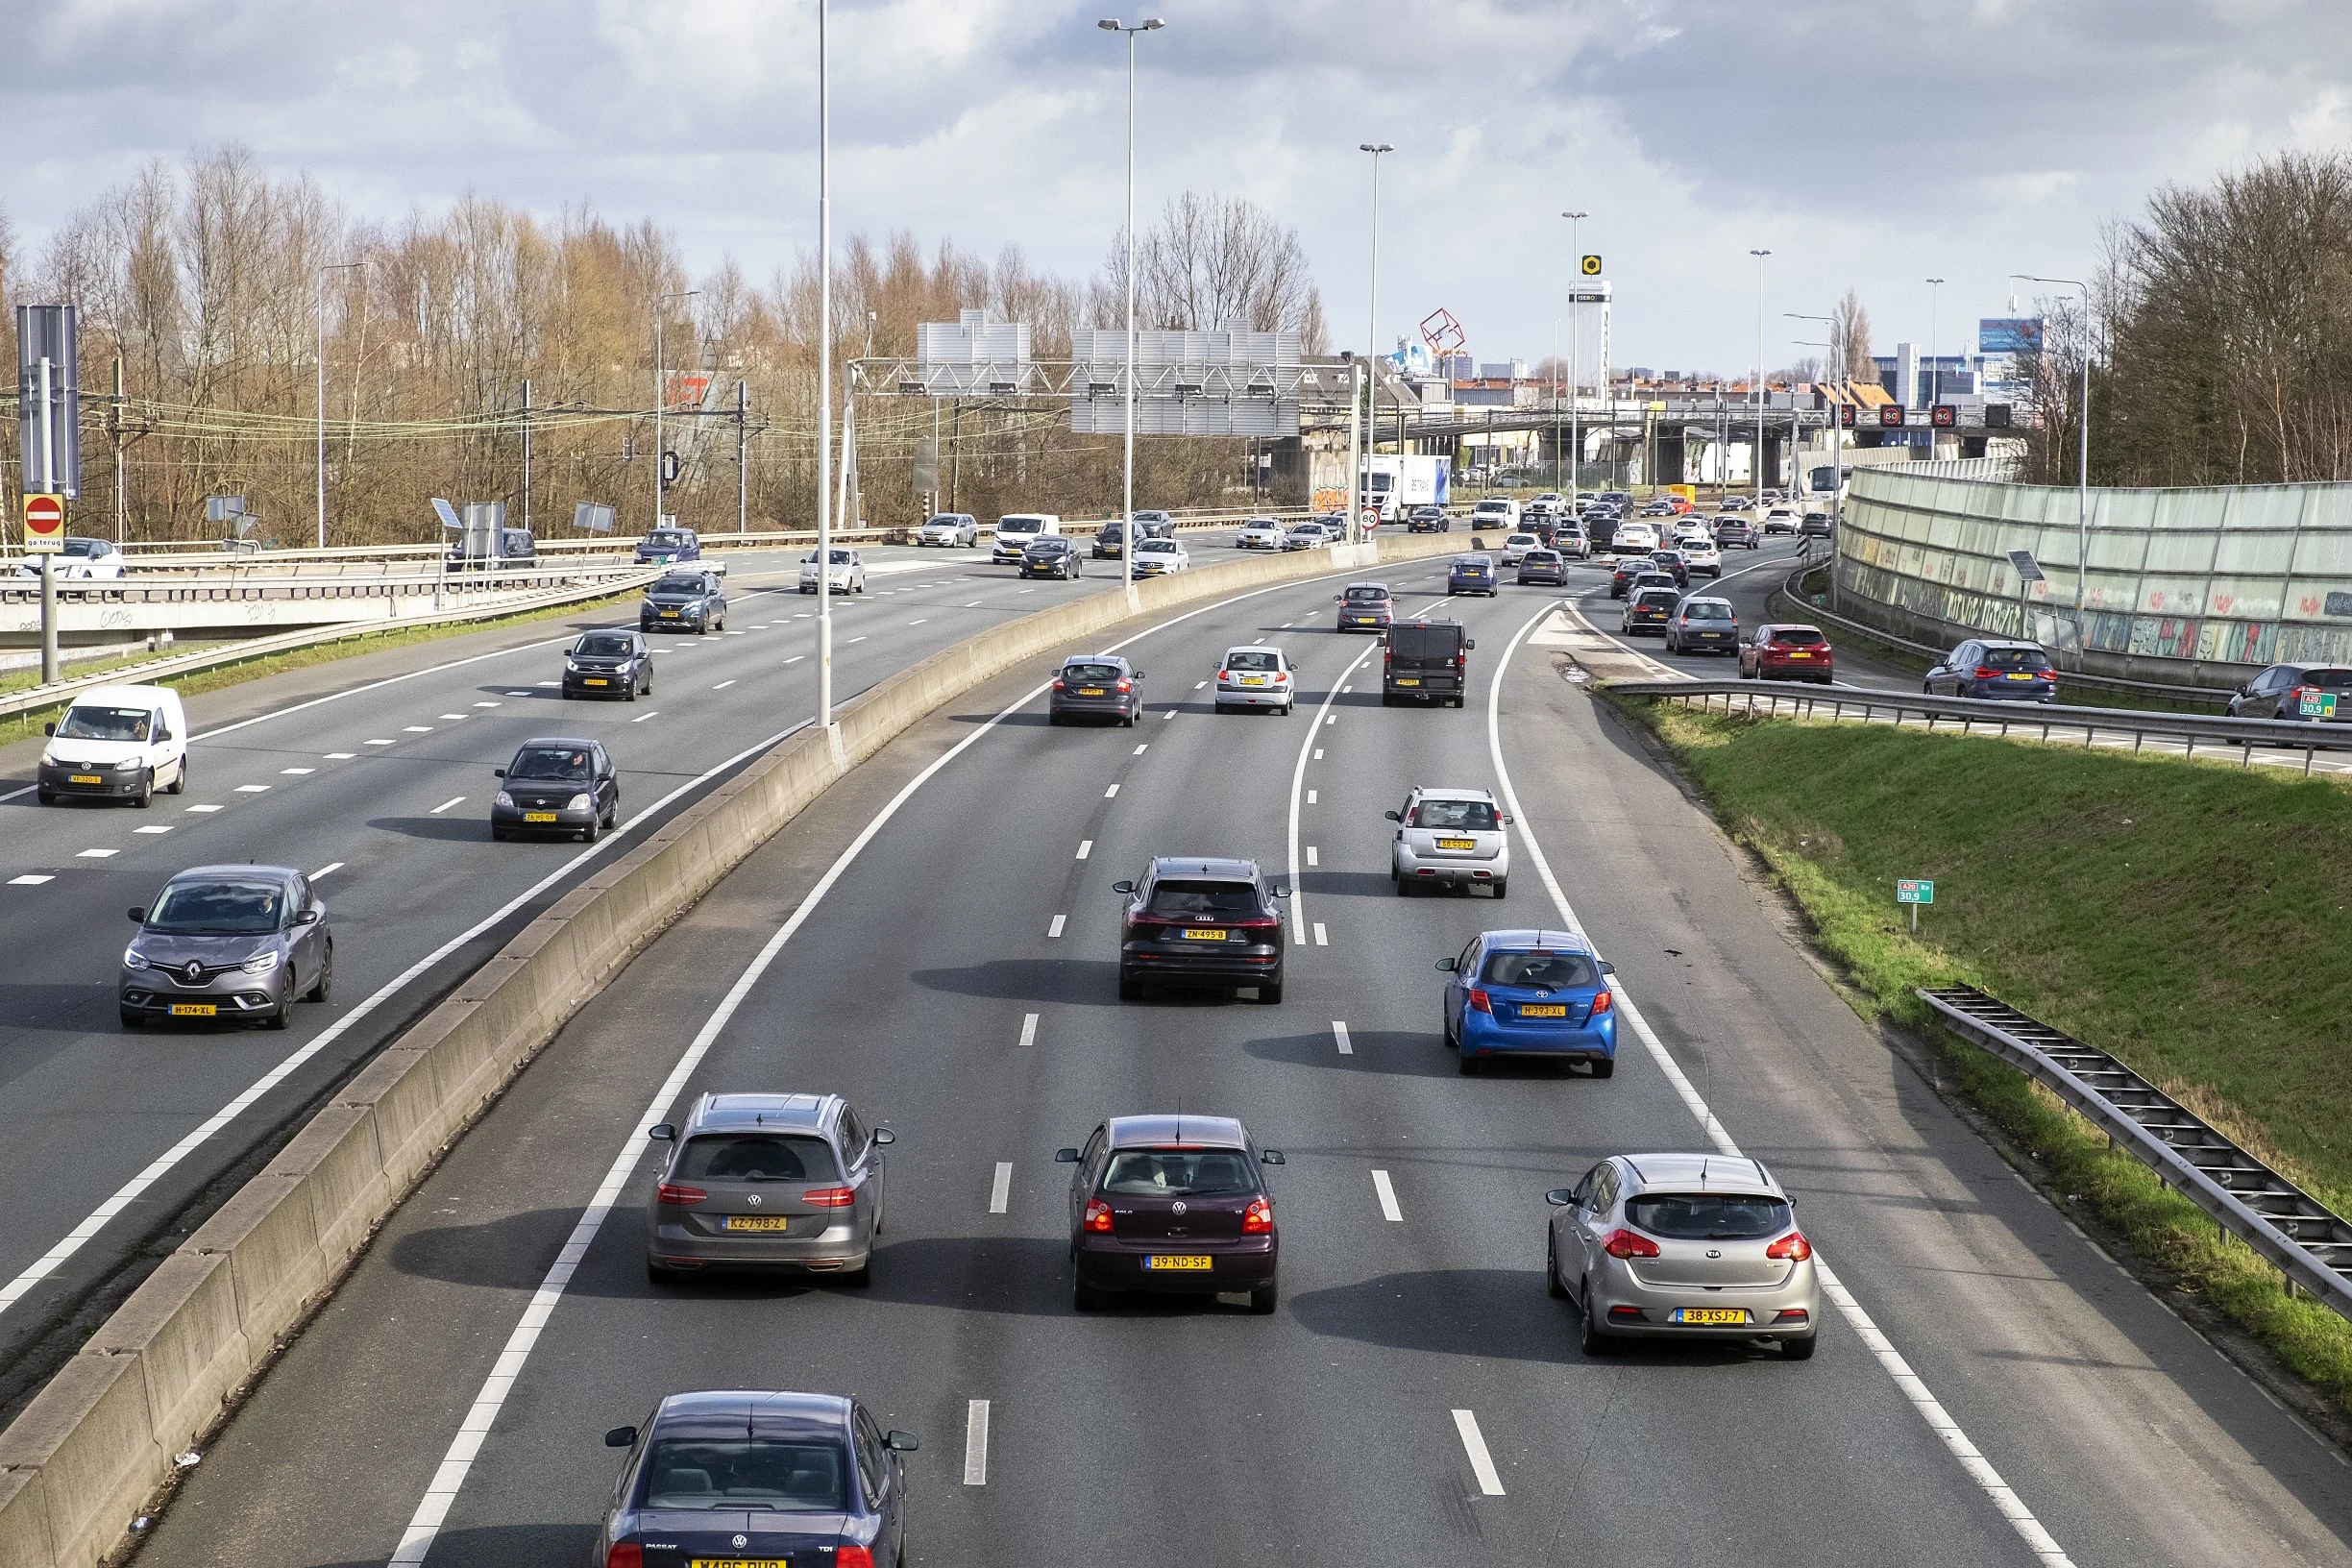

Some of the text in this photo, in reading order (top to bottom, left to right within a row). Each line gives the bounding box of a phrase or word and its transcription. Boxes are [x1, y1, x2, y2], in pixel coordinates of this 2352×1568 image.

[1525, 1006, 1561, 1015] H-393-XL
[730, 1217, 781, 1228] KZ-798-Z
[1154, 1257, 1208, 1267] 39-ND-SF
[1688, 1311, 1738, 1321] 38-XSJ-7
